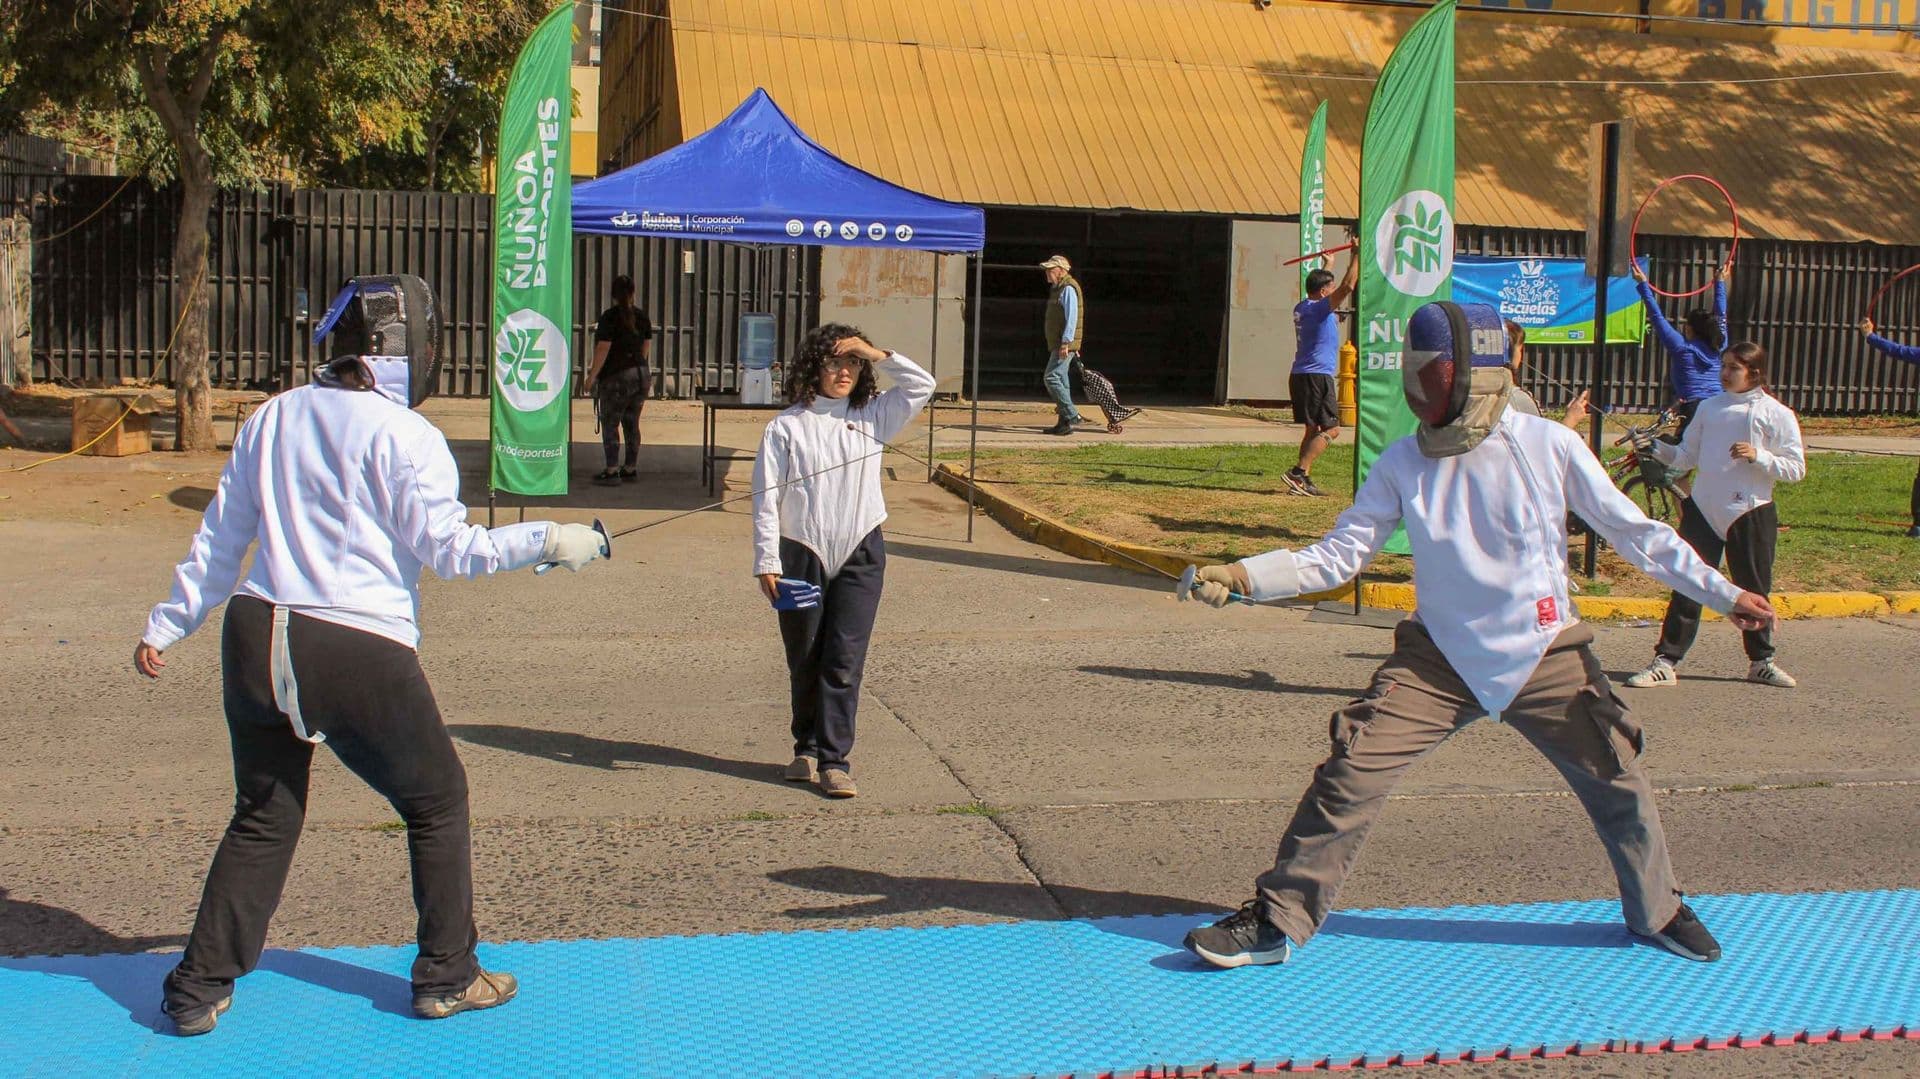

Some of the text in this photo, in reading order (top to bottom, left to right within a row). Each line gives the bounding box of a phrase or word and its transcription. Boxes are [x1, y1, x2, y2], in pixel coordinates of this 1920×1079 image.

[505, 149, 538, 289] ÑUÑOA
[641, 210, 681, 224] Ñuñoa
[691, 214, 745, 225] Corporación
[641, 222, 684, 231] Deportes
[691, 225, 735, 235] Municipal
[1500, 301, 1557, 316] Escuelas
